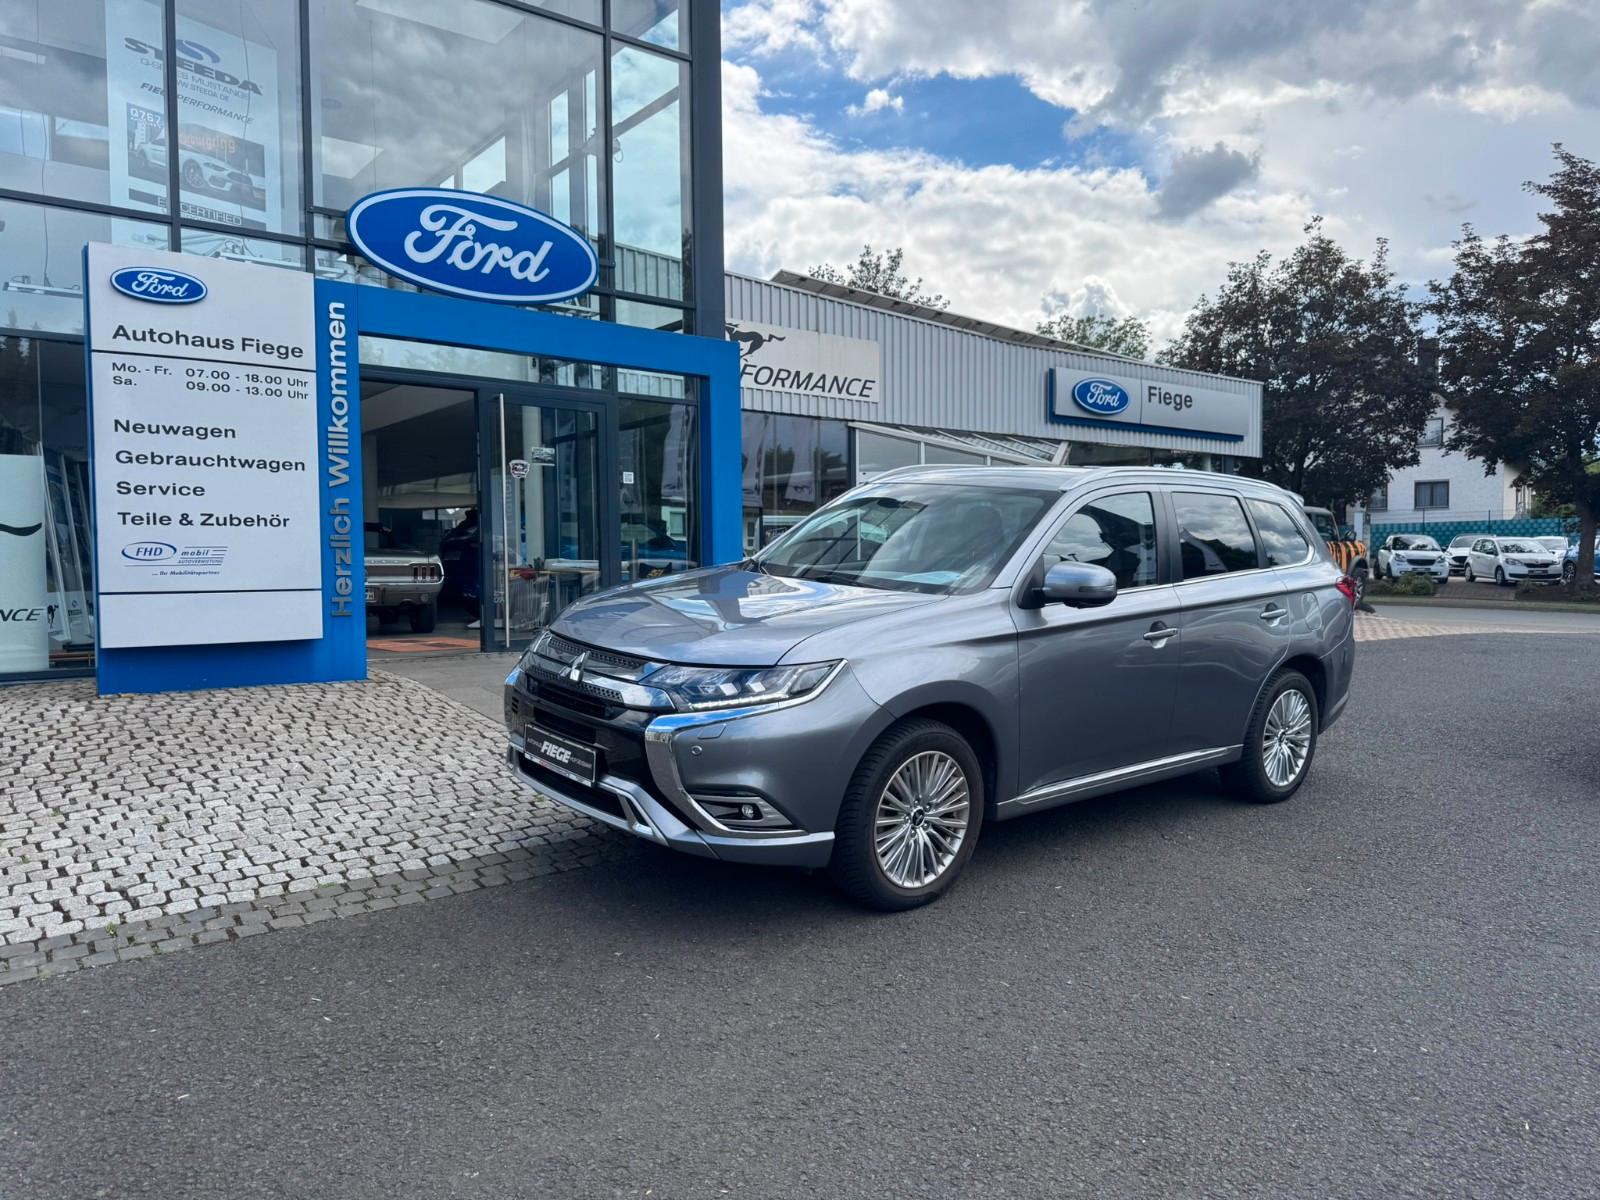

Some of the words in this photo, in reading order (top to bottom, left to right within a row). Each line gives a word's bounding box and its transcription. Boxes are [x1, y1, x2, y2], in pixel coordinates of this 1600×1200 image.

[404, 204, 553, 283] Ford
[131, 271, 188, 297] Ford
[112, 325, 234, 350] Autohaus
[242, 338, 303, 359] Fiege
[113, 363, 141, 373] Mo.
[155, 366, 171, 375] Fr.
[186, 368, 230, 380] 07.00
[245, 374, 281, 384] 18.00
[288, 378, 308, 387] Uhr
[113, 376, 136, 385] Sa.
[186, 381, 230, 392] 09.00
[246, 387, 282, 397] 13.00
[288, 390, 308, 399] Uhr
[327, 302, 349, 487] Willkommen
[1087, 382, 1120, 407] Ford
[1148, 386, 1193, 411] Fiege
[114, 419, 235, 440] Neuwagen
[116, 450, 305, 473] Gebrauchtwagen
[117, 481, 205, 496] Service
[117, 512, 172, 525] Teile
[179, 513, 193, 526] &
[200, 513, 289, 527] Zubehör
[135, 547, 163, 557] FHD
[330, 498, 352, 617] Herzlich
[541, 741, 572, 764] FIEGE
